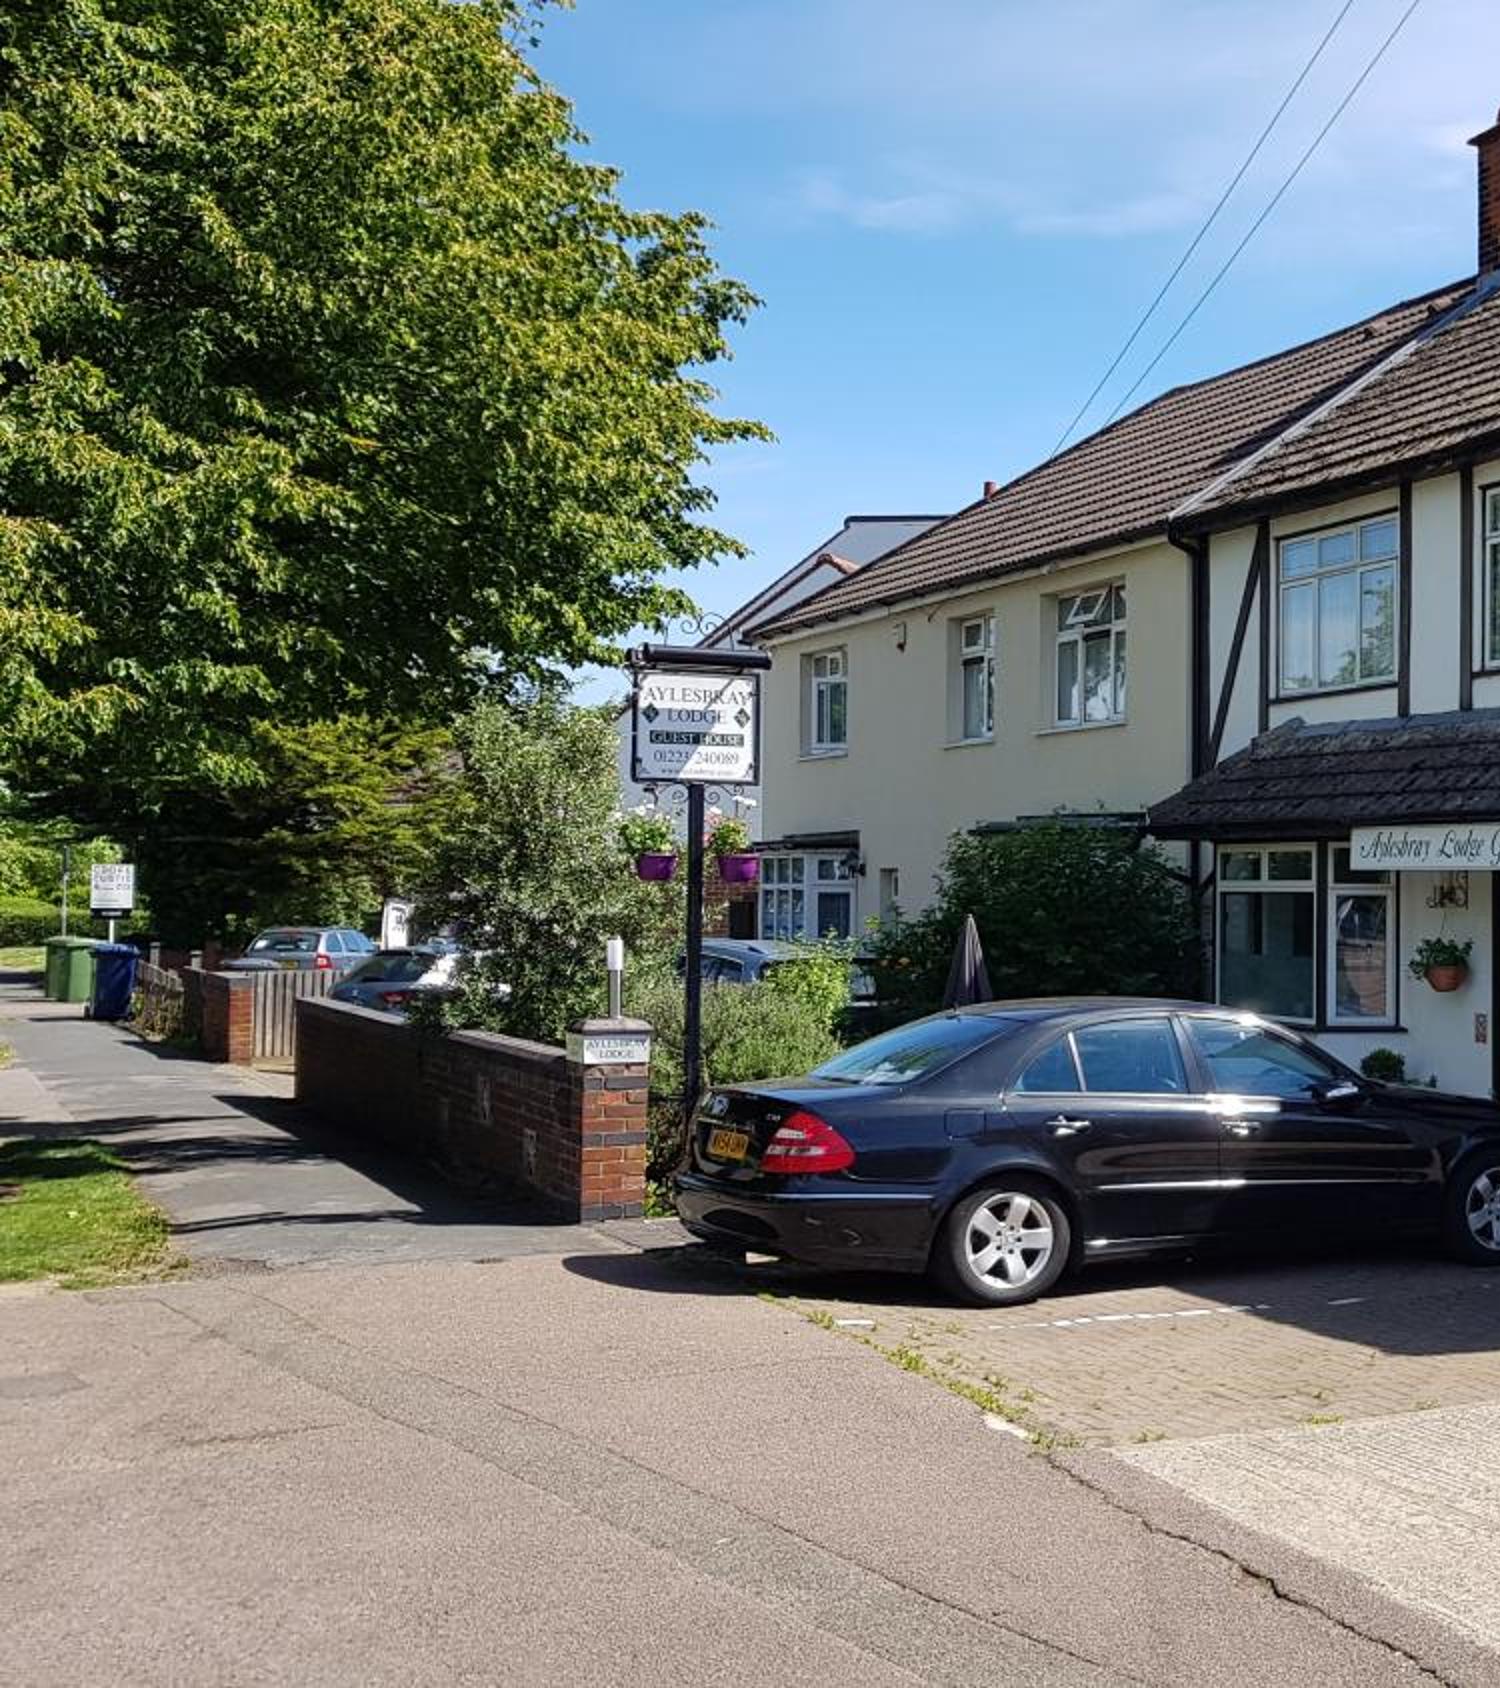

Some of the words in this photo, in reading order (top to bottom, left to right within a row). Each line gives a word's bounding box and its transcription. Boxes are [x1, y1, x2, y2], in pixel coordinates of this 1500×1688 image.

[644, 687, 750, 706] AYLESBRAY
[668, 708, 727, 724] LODGE
[651, 731, 695, 744] GUEST
[699, 734, 743, 746] HOUSE
[1360, 831, 1430, 862] Aylesbray
[1440, 829, 1484, 862] Lodge
